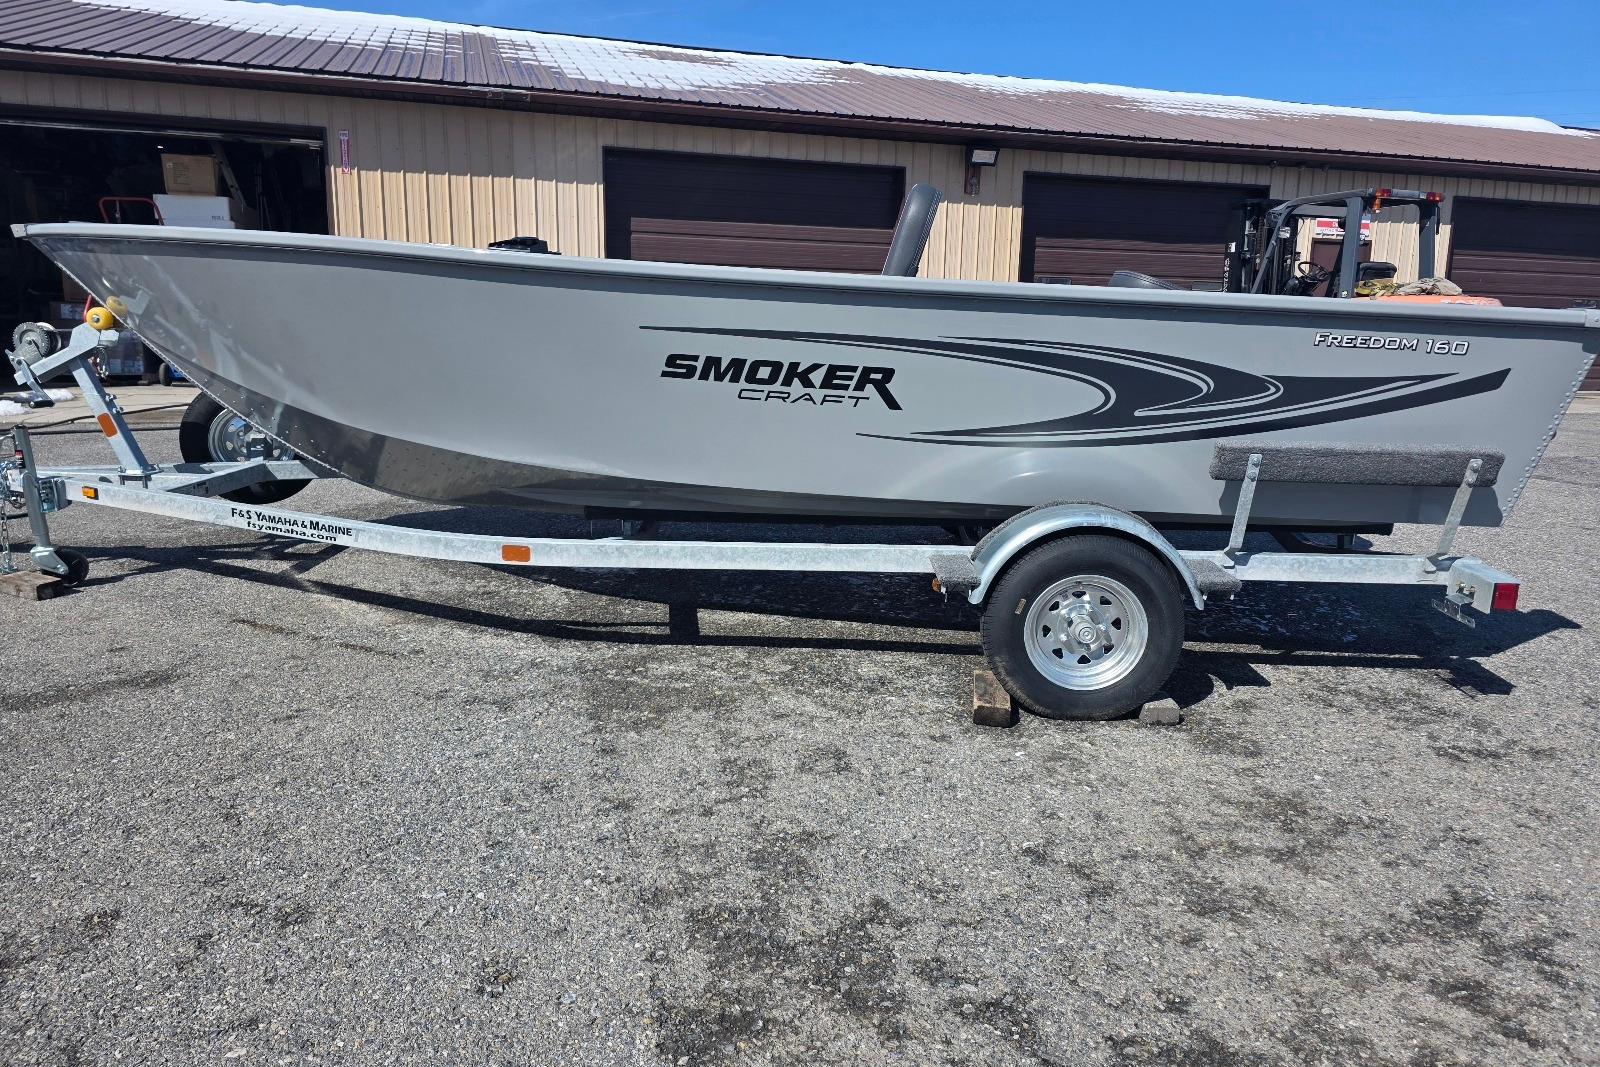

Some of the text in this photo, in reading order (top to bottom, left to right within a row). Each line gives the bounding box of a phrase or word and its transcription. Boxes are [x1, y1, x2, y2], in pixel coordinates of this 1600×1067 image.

[1314, 332, 1470, 355] FREEDOM 160
[660, 353, 903, 411] SMOKER
[737, 388, 870, 408] CRAFT
[246, 521, 337, 541] fsyamaha.com
[254, 511, 300, 528] YAMAHA
[309, 520, 353, 537] MARINE
